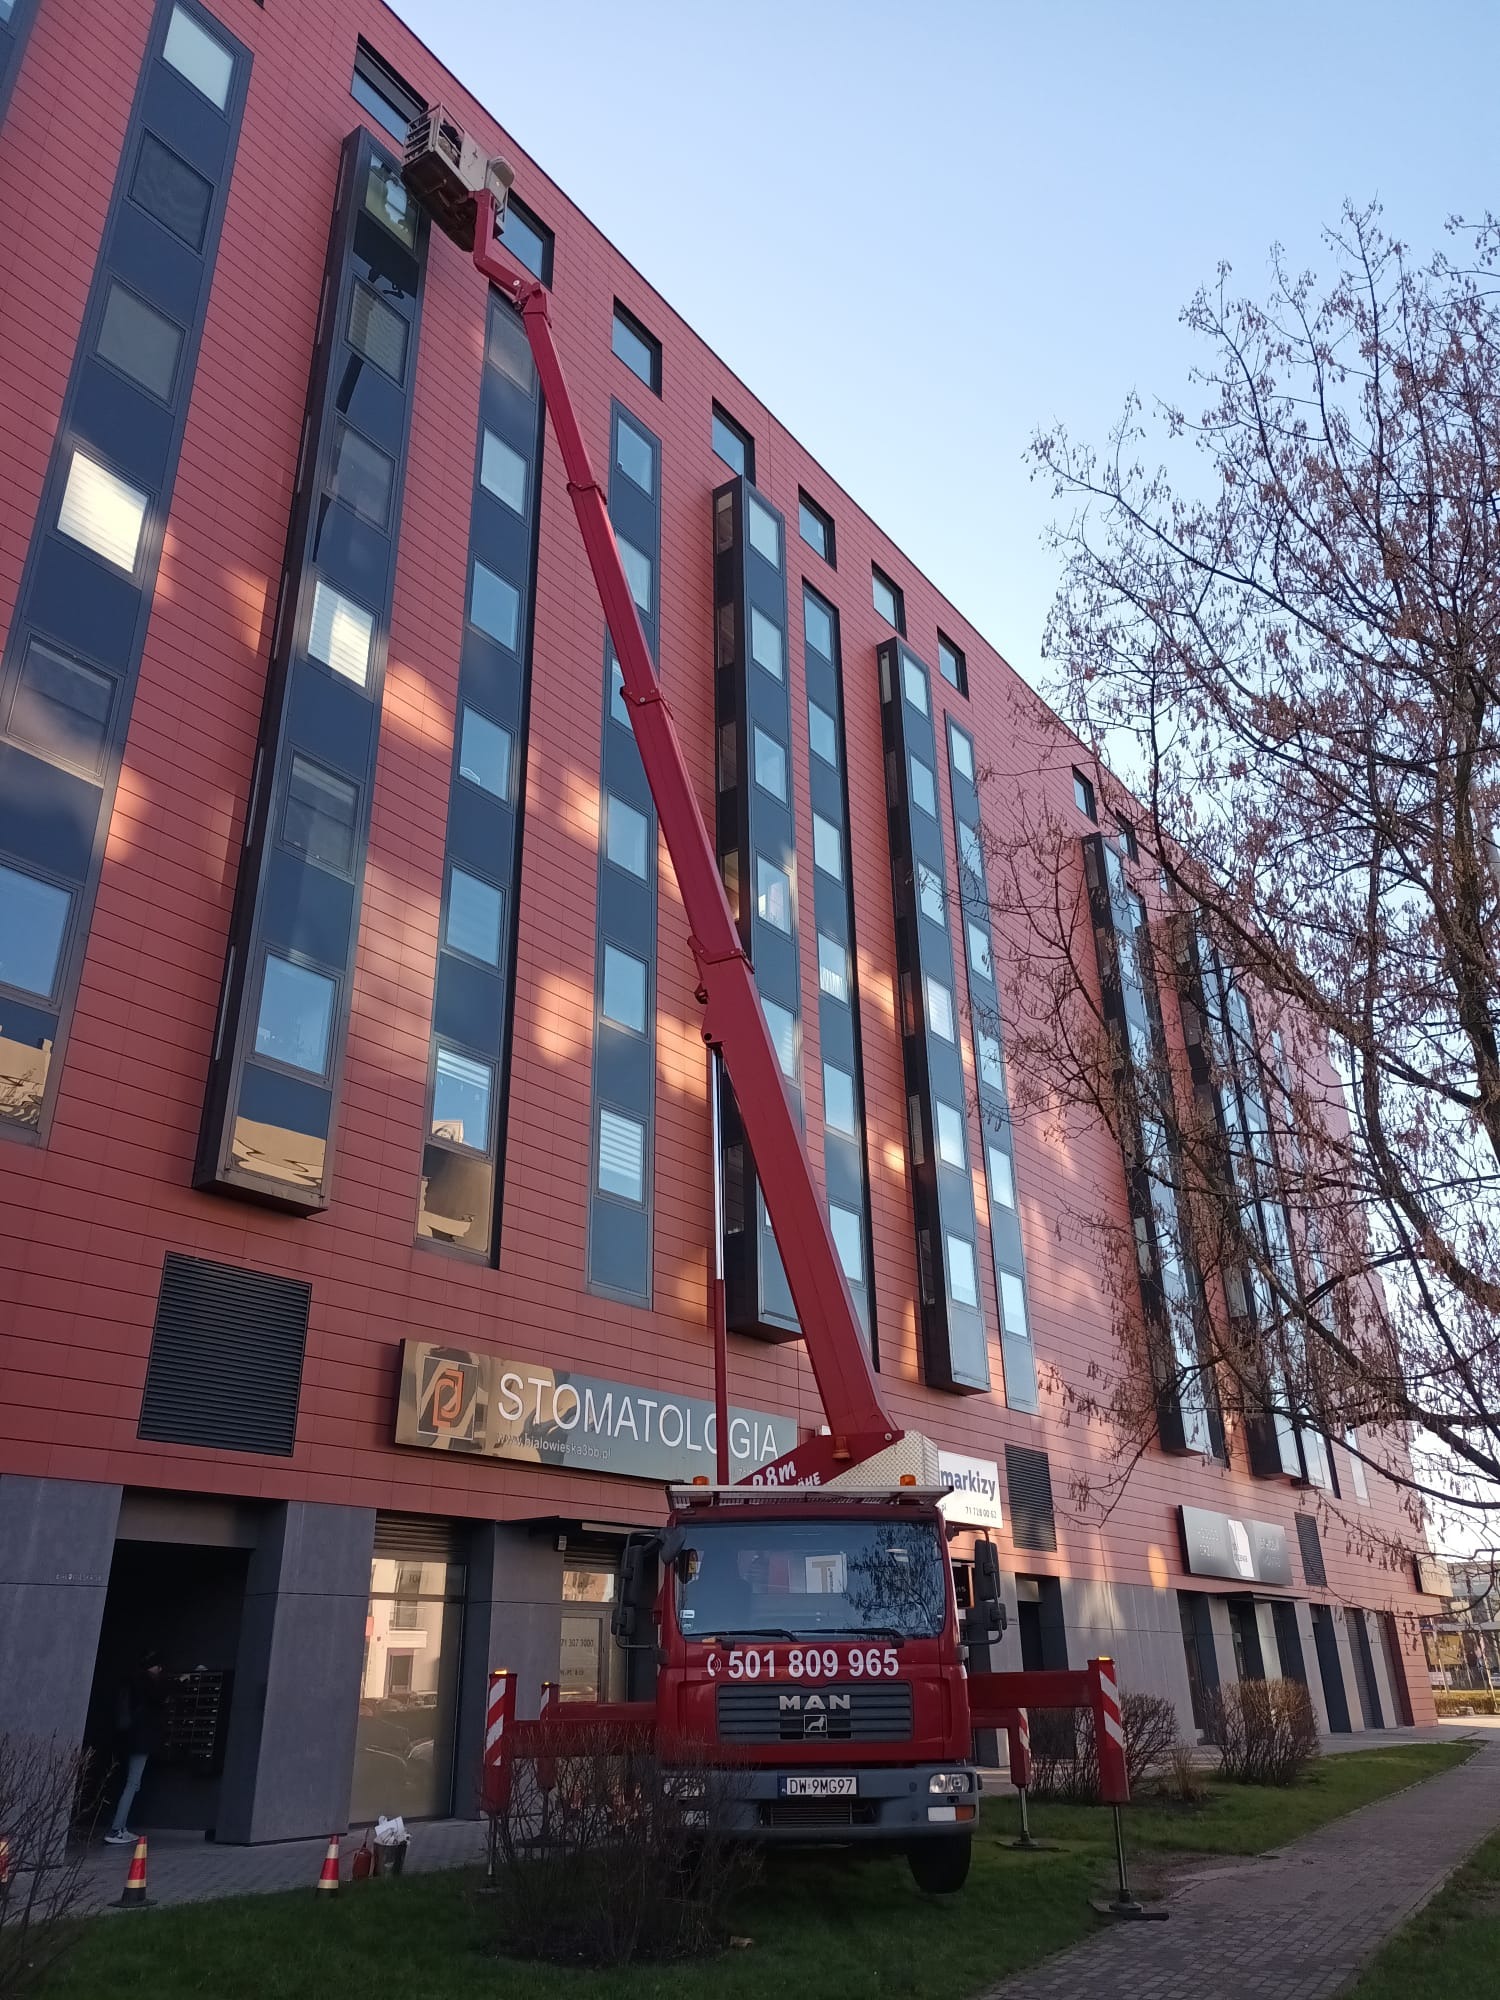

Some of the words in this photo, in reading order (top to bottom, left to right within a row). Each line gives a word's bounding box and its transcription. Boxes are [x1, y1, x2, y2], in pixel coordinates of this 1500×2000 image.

[498, 1373, 779, 1462] STOMATOLOGIA
[940, 1469, 996, 1502] markizy
[728, 1650, 776, 1679] 501
[788, 1649, 839, 1678] 809
[848, 1648, 900, 1677] 965
[779, 1694, 851, 1711] MAN
[789, 1778, 807, 1794] DW
[811, 1778, 853, 1794] 9MG97
